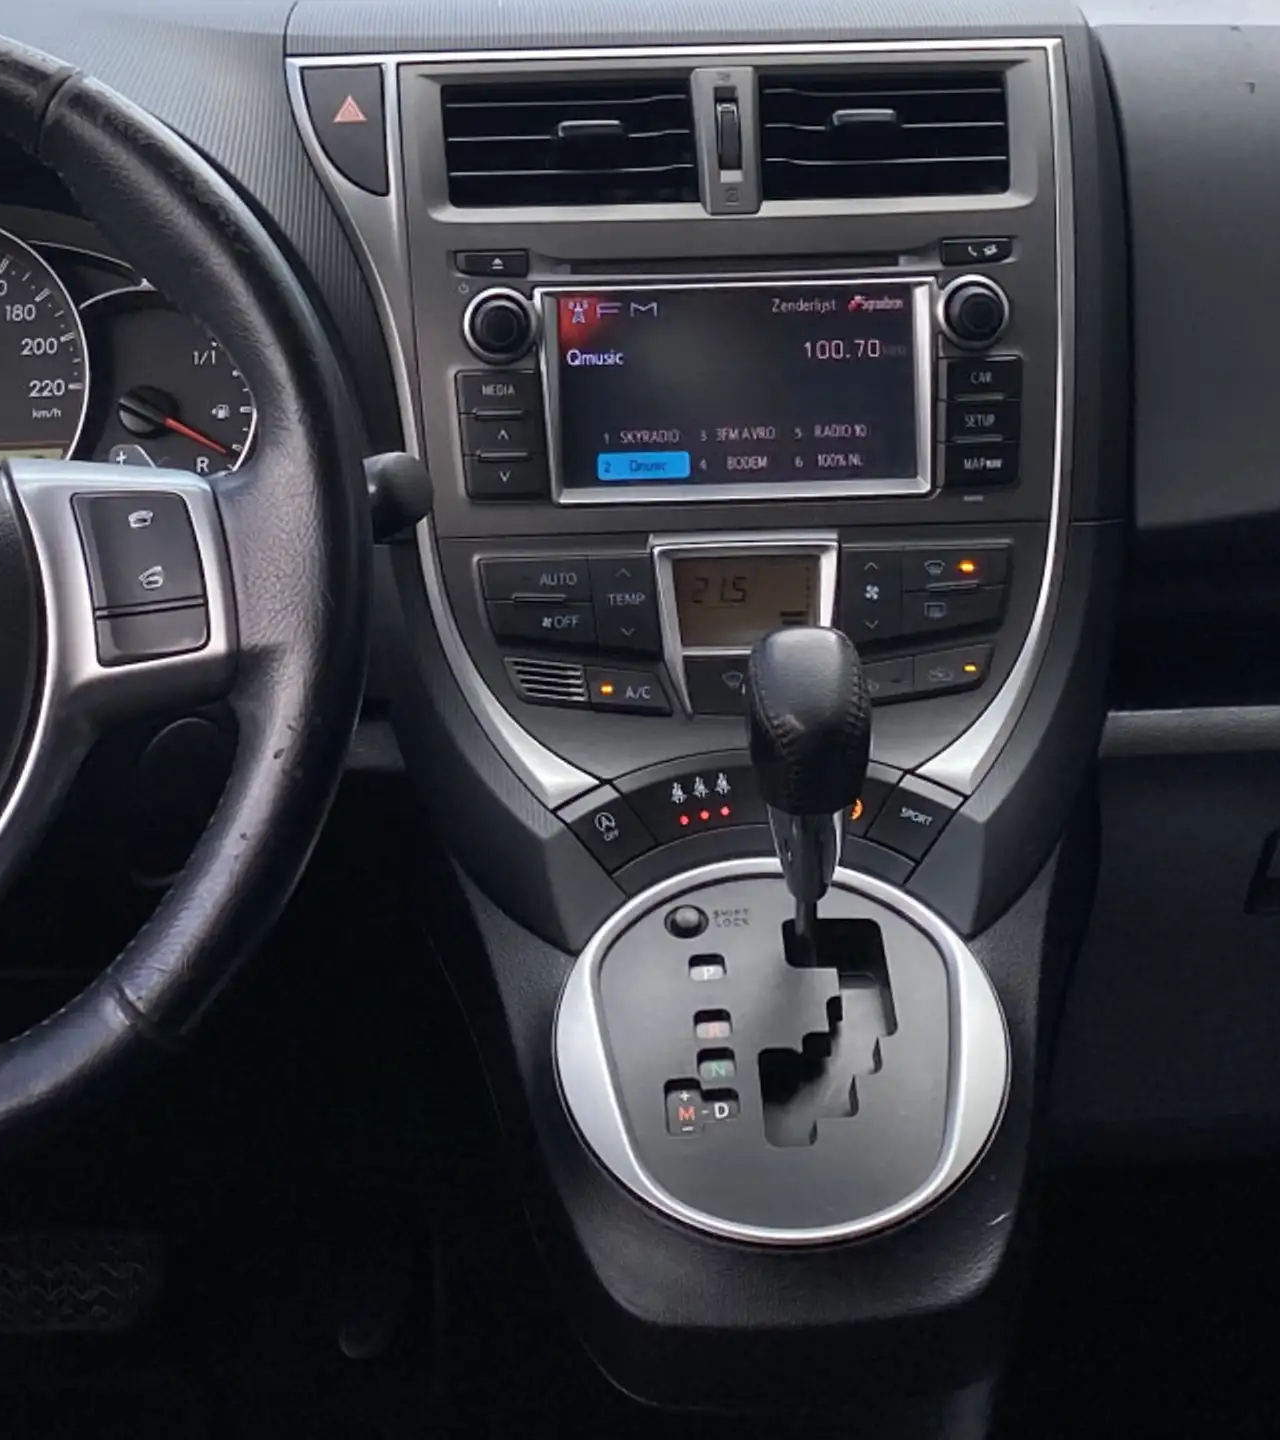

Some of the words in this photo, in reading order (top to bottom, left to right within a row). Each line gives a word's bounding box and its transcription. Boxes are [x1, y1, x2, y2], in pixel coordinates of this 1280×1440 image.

[5, 304, 36, 321] 180
[21, 337, 58, 355] 200
[804, 340, 880, 359] 100.70
[193, 350, 216, 365] 1/1
[566, 349, 624, 366] Qmusic
[970, 371, 992, 384] CAR
[28, 379, 65, 397] 220
[32, 408, 61, 418] km/h
[196, 456, 209, 473] R
[540, 572, 577, 586] AUTO
[608, 593, 645, 606] TEMP
[554, 614, 581, 629] OFF
[625, 686, 651, 699] A/C
[703, 967, 713, 980] P
[711, 1062, 726, 1077] N
[678, 1106, 695, 1121] M
[713, 1102, 729, 1118] D
